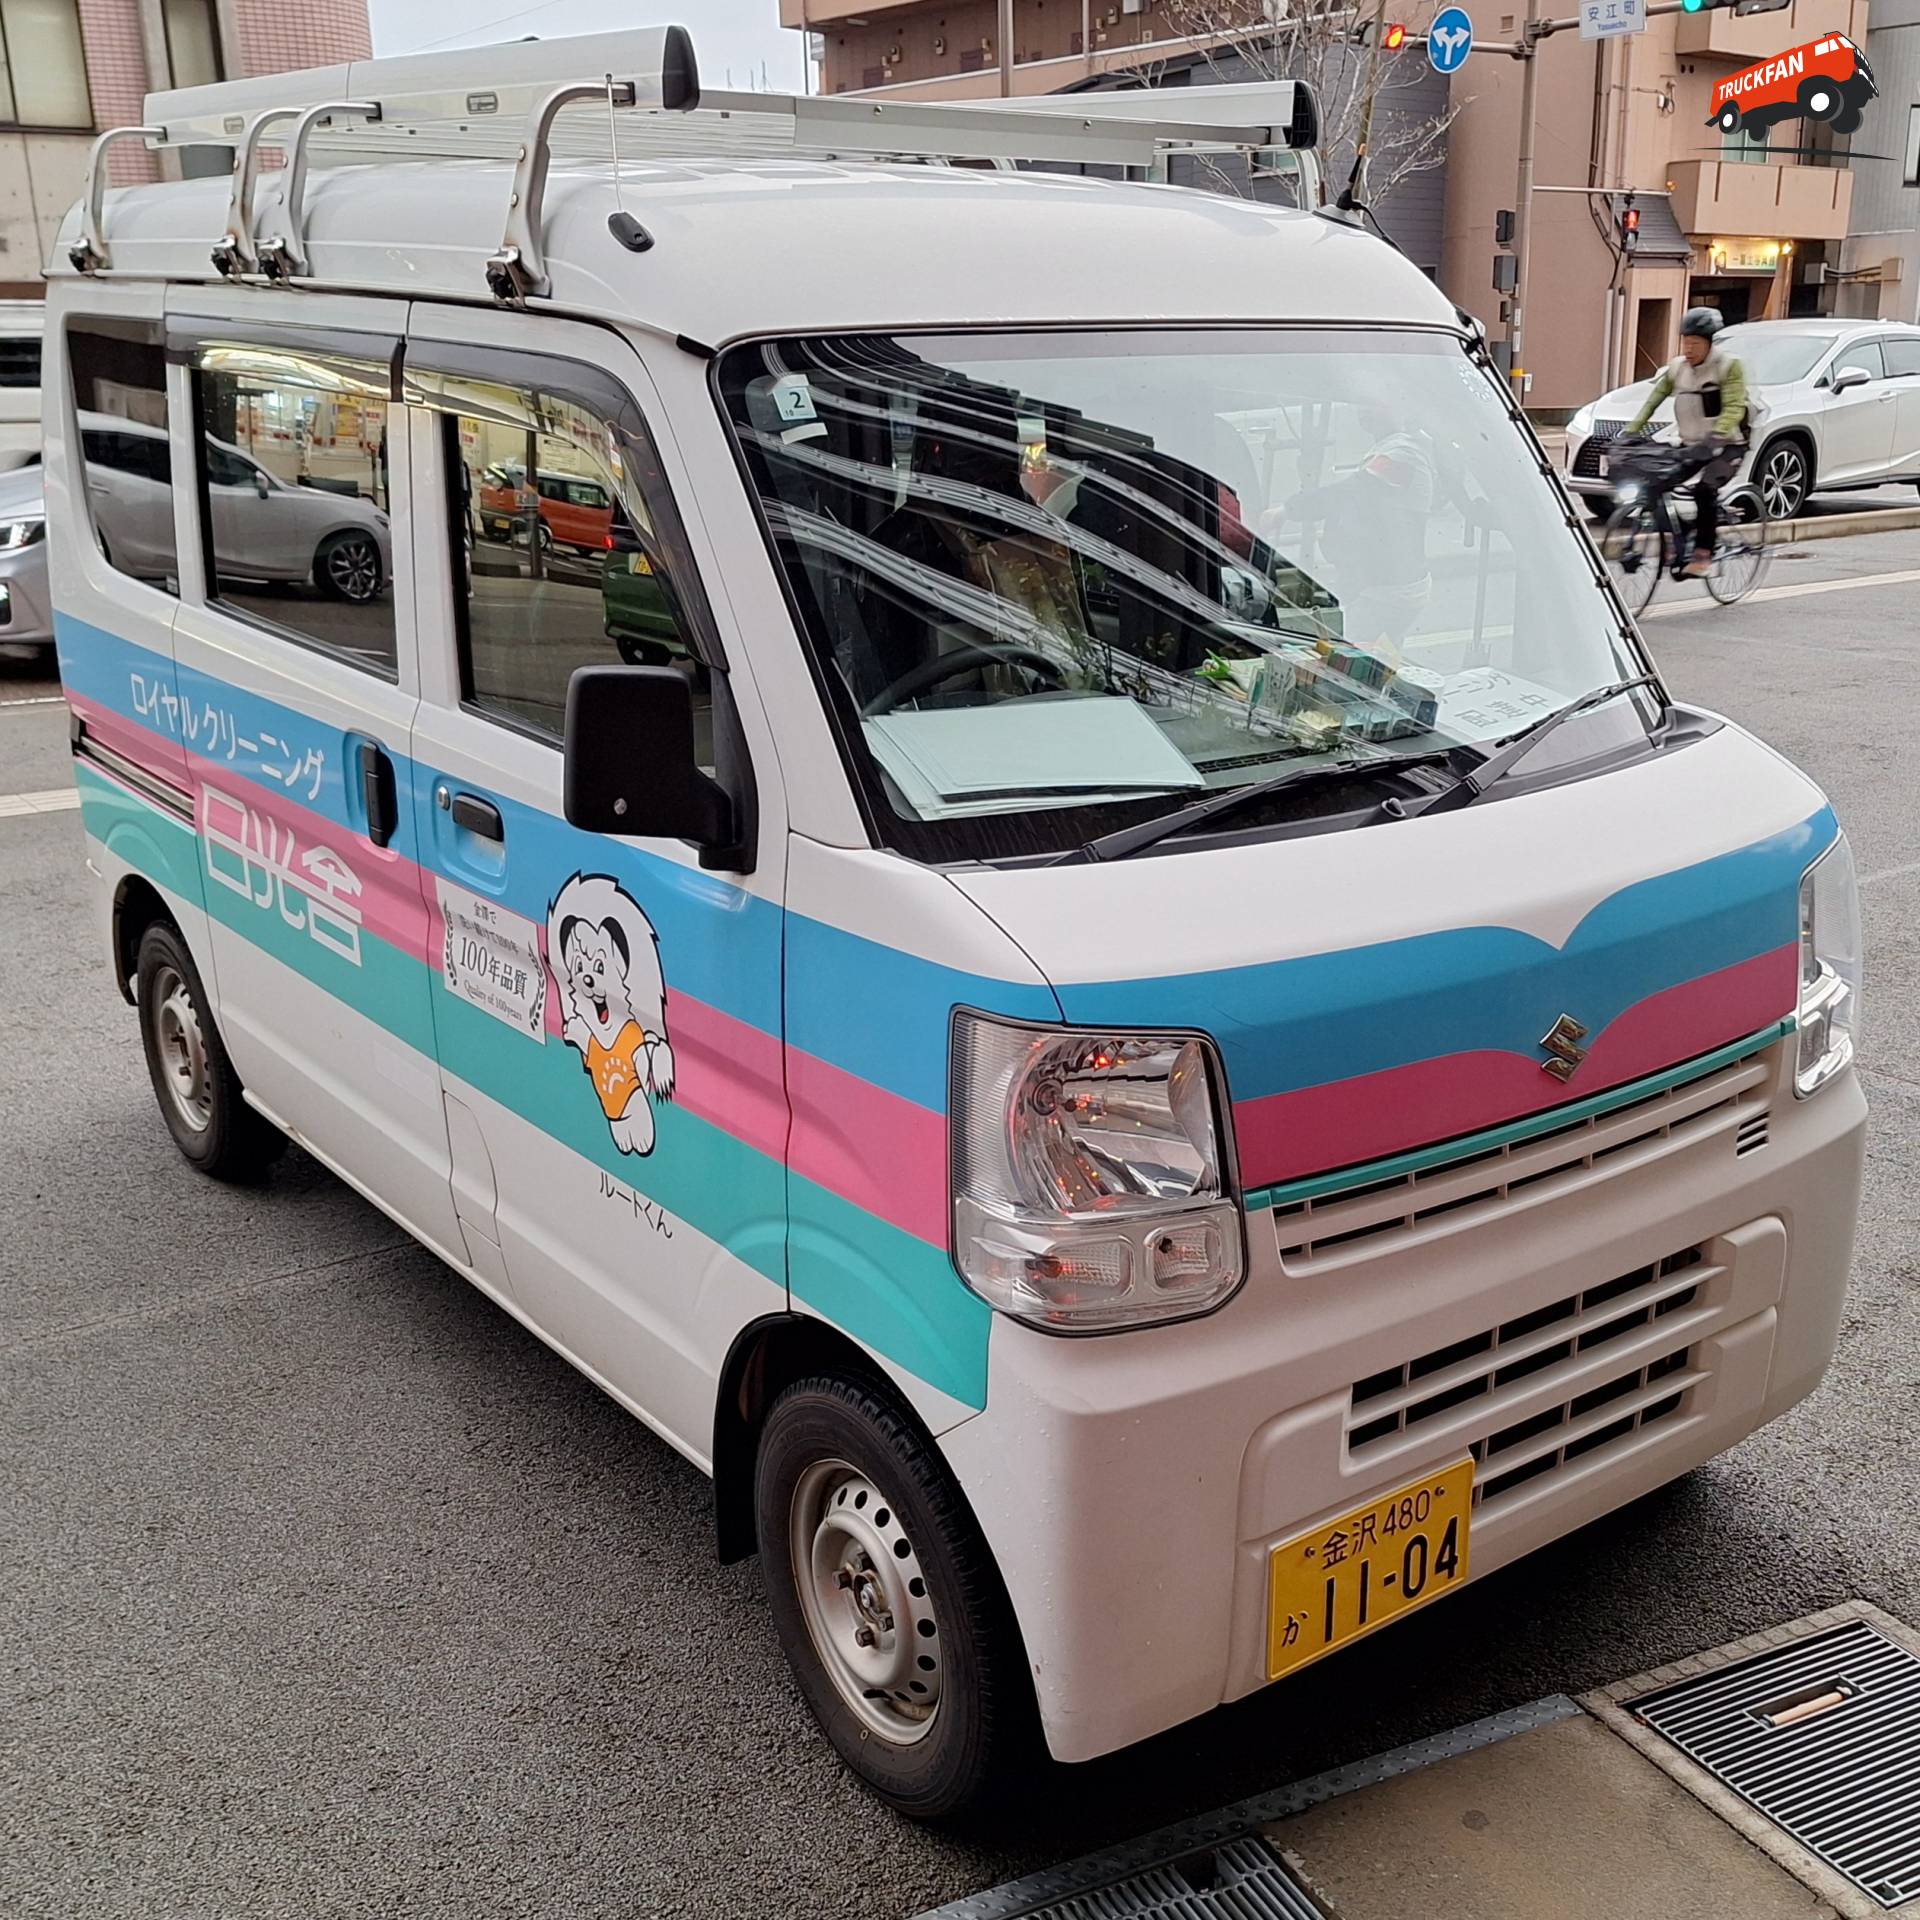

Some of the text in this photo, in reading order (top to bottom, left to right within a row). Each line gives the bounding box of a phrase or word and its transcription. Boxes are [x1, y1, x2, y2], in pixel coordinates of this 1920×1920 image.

[789, 392, 805, 408] 2
[130, 673, 324, 800] ロイヤルクリーニング
[460, 937, 527, 1000] 100年品質
[600, 1171, 672, 1239] ルートくん
[1322, 1489, 1431, 1569] 金沢 480
[1281, 1516, 1459, 1647] か 11-04
